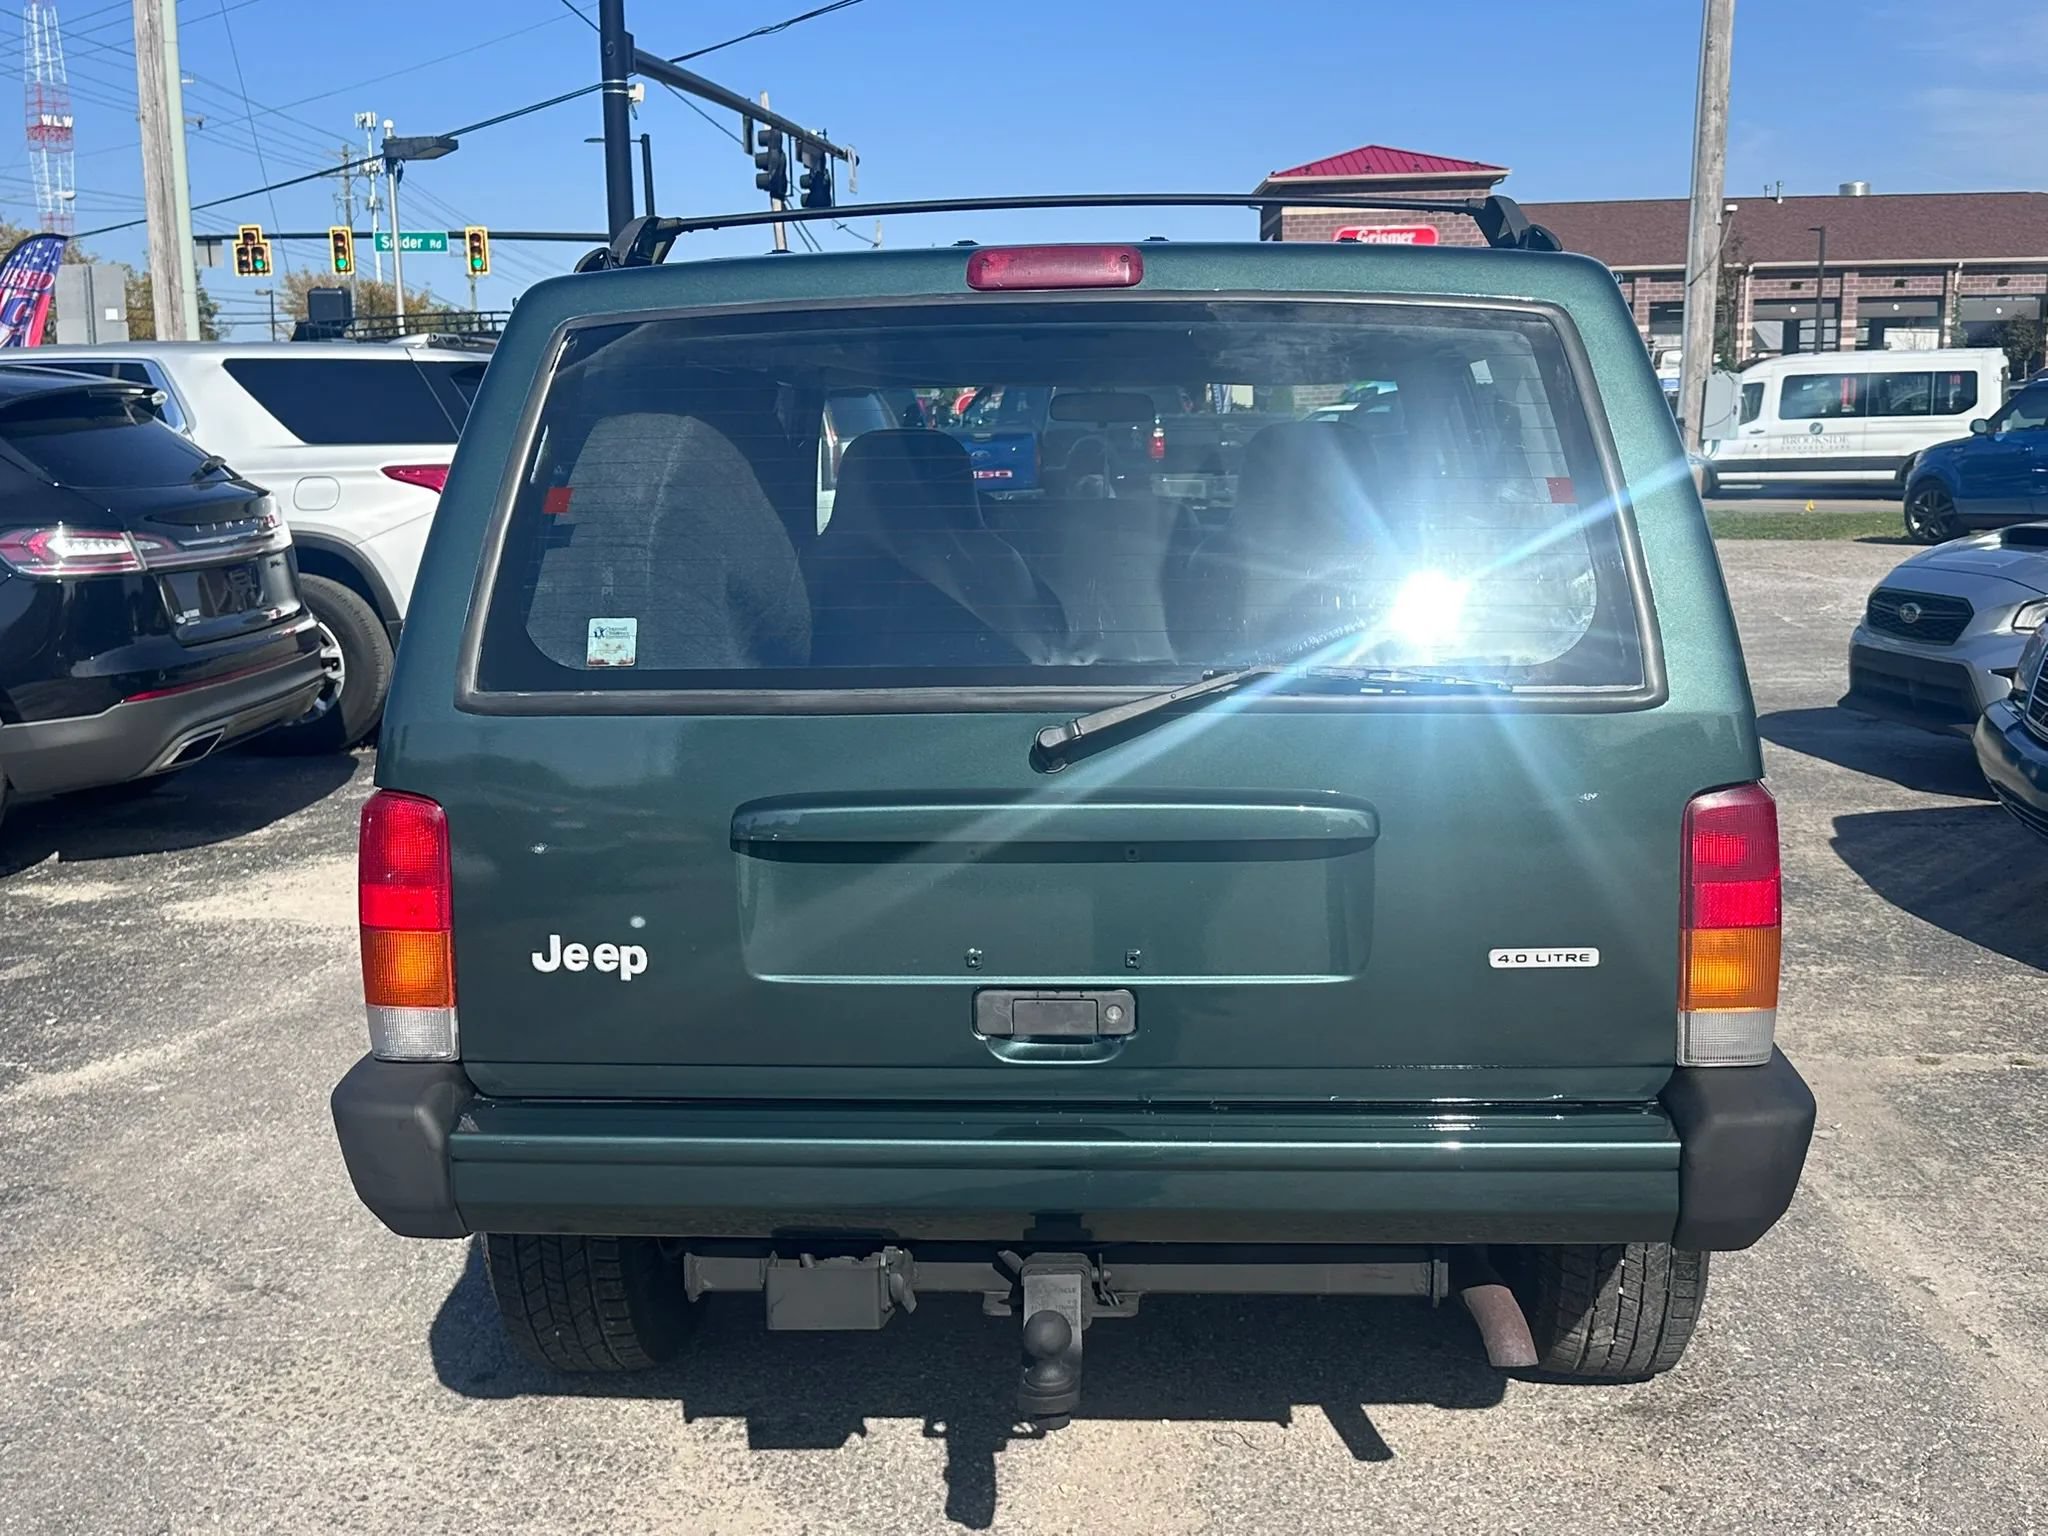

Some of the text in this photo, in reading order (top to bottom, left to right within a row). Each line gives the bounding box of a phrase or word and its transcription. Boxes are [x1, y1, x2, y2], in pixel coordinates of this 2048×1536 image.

[41, 114, 73, 128] WLW
[429, 239, 442, 249] Rd
[1356, 230, 1416, 245] Grismer
[1781, 434, 1850, 446] BROOKSIDE
[531, 934, 648, 981] Jeep
[1497, 953, 1591, 963] 4.0 LITRE
